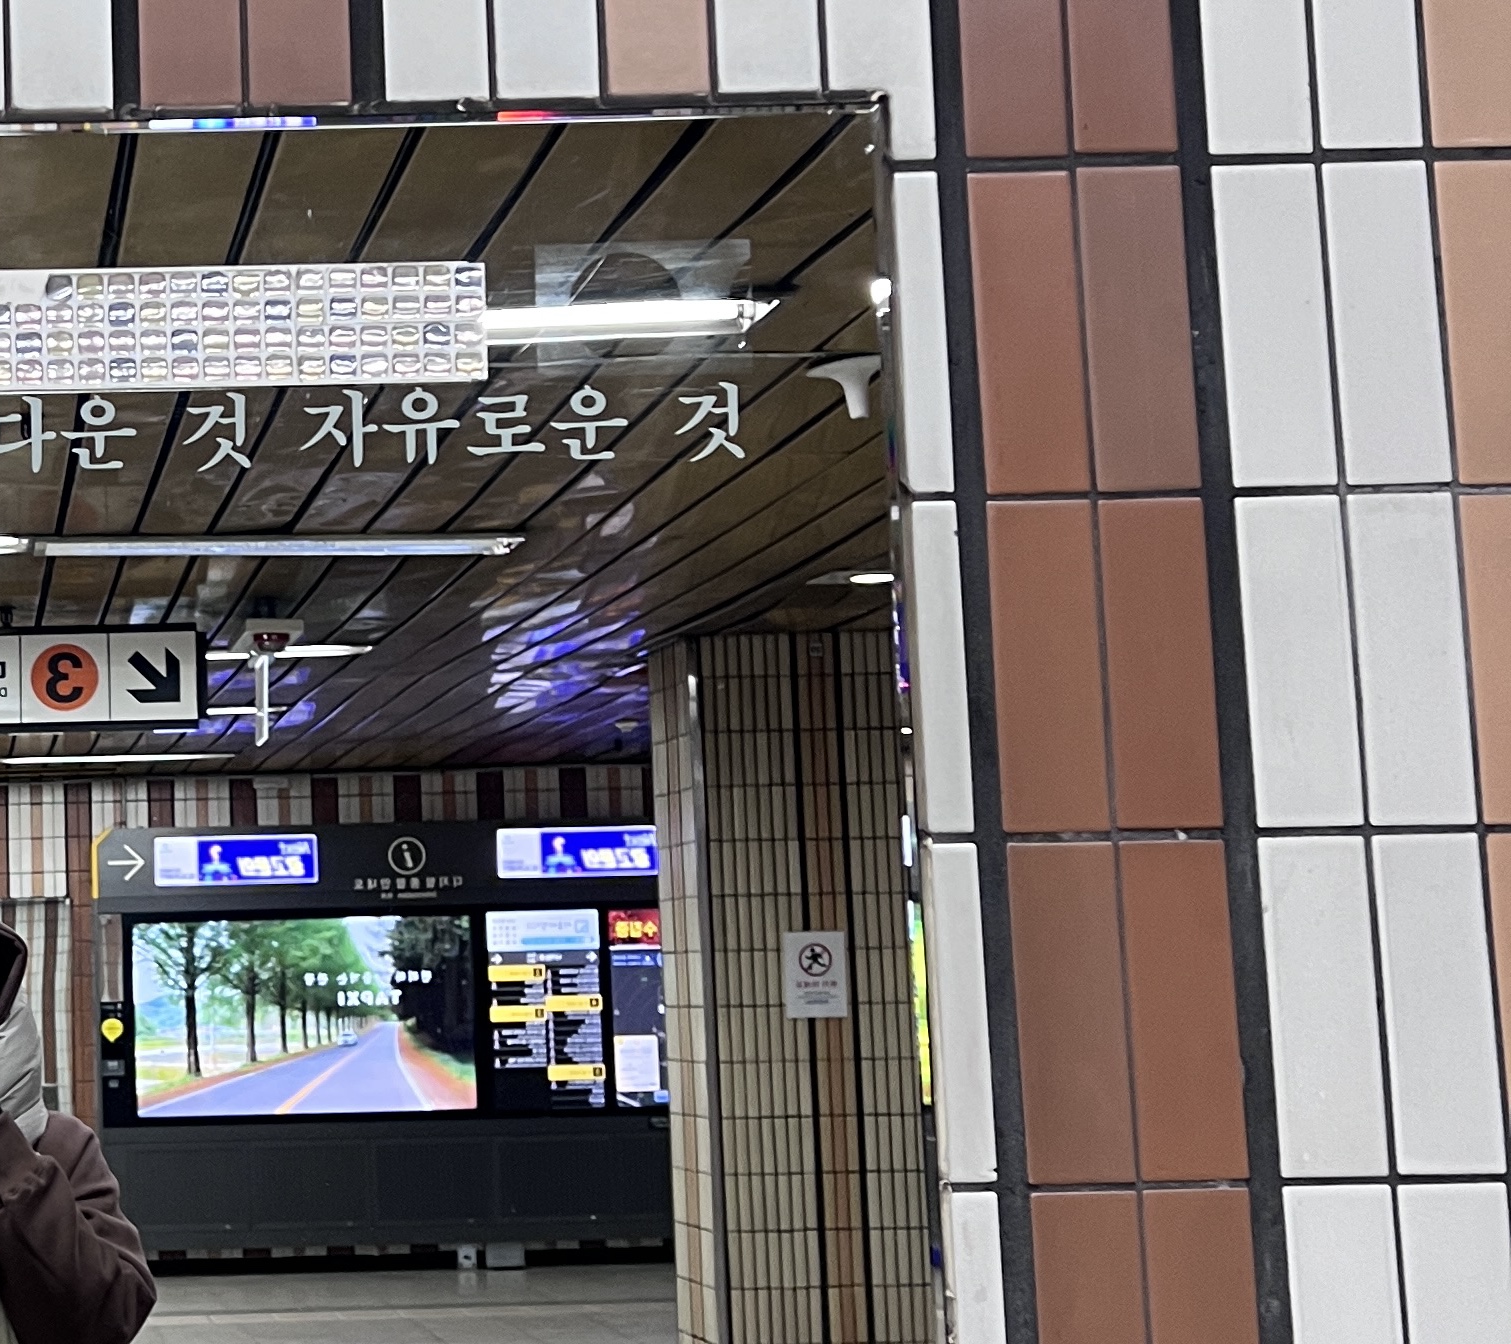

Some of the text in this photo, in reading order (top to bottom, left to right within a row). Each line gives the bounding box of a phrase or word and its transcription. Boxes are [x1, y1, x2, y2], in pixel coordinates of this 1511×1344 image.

[183, 393, 251, 472] 것
[299, 385, 629, 467] 자유로운
[675, 382, 745, 462] 것
